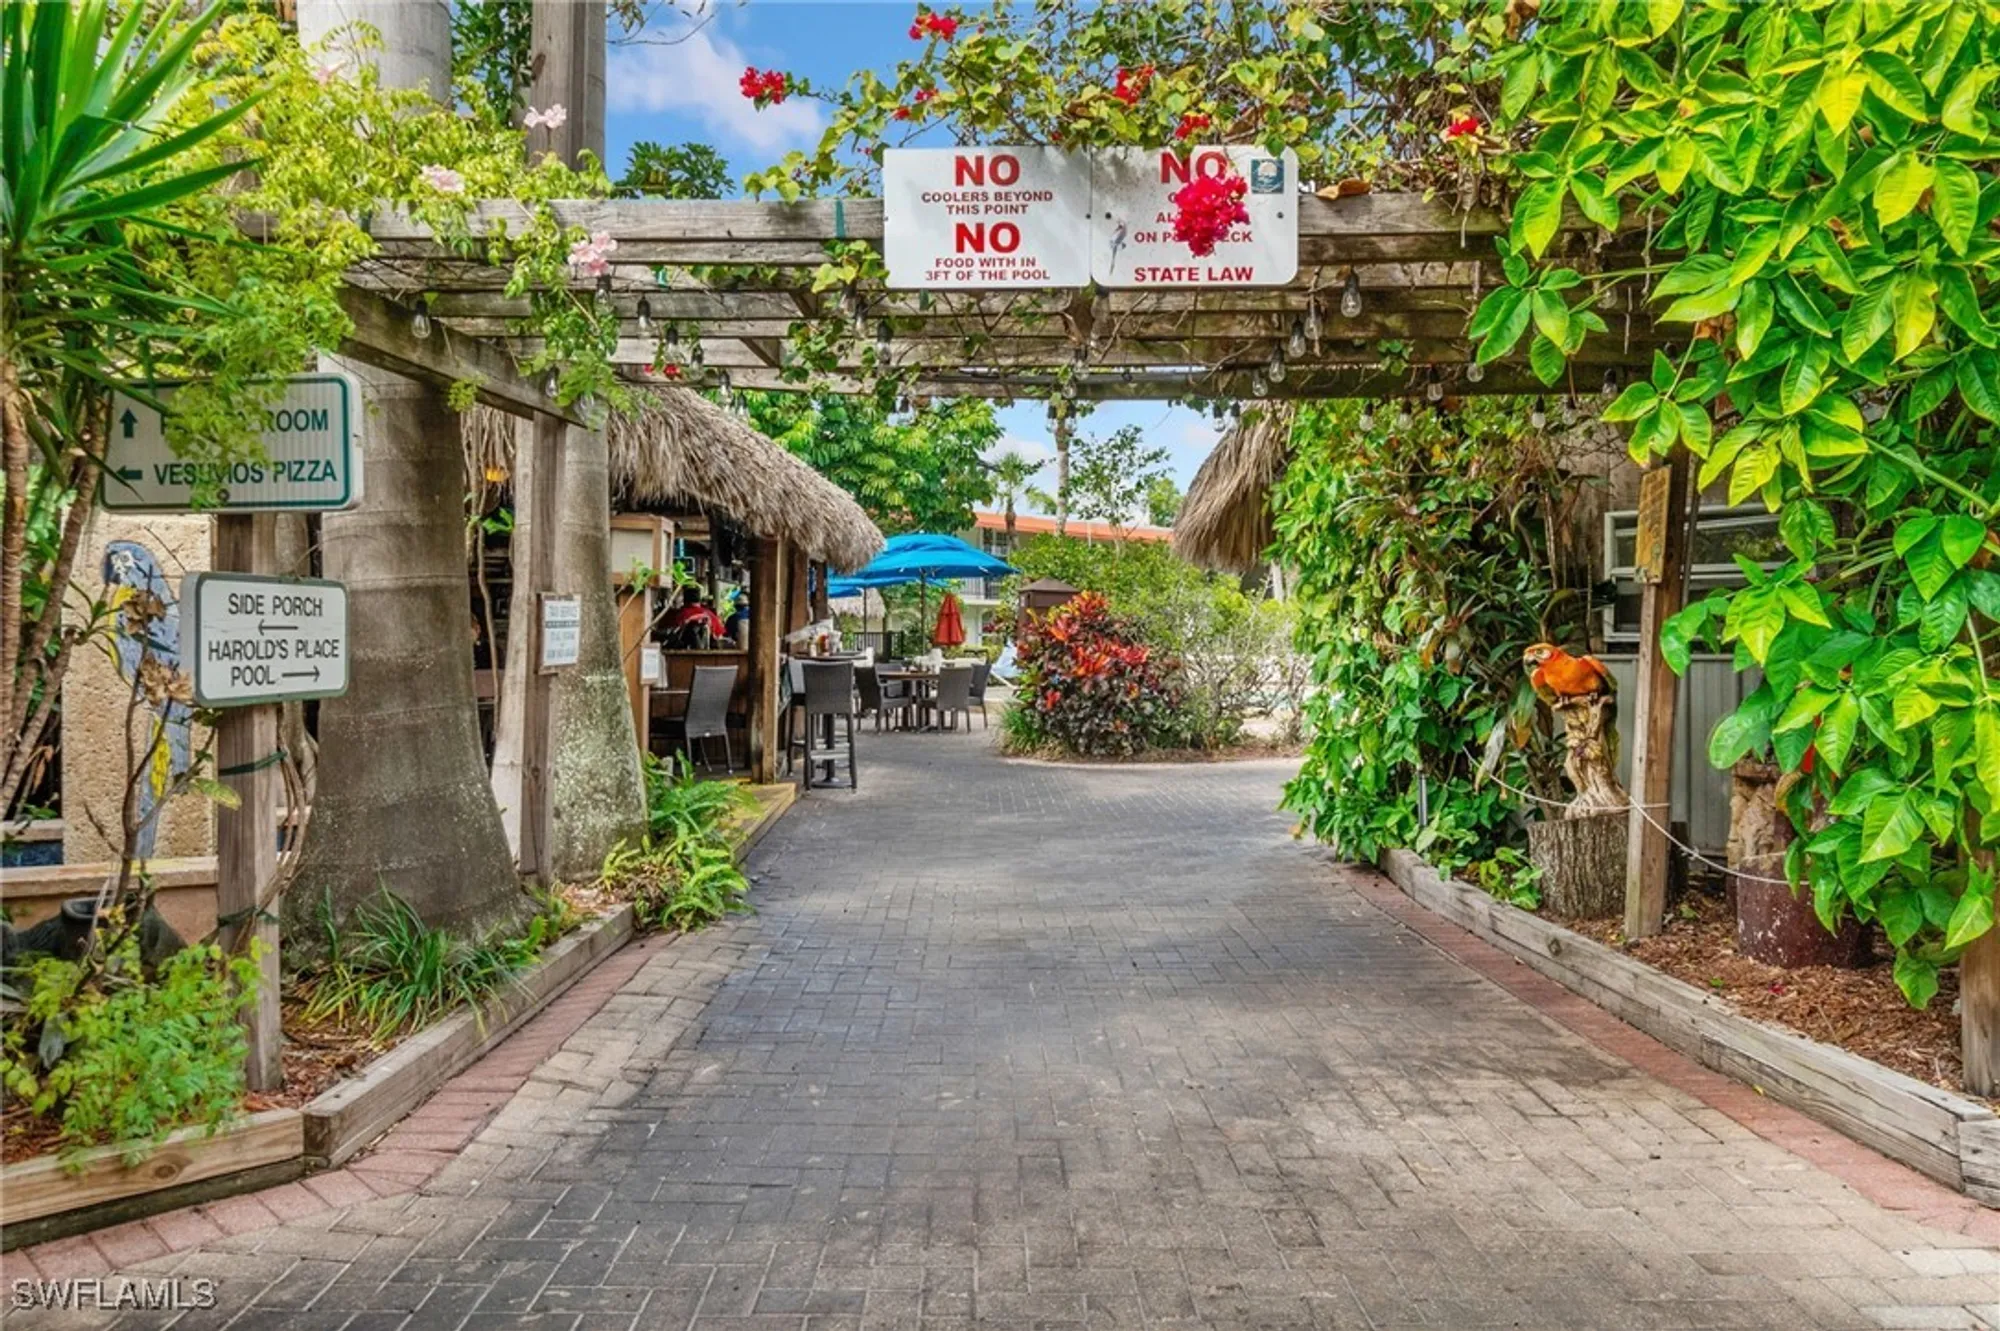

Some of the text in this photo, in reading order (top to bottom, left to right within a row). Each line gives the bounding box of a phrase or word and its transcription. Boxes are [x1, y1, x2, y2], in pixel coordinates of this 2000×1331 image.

[955, 154, 1021, 187] NO
[1160, 151, 1229, 184] NO
[921, 191, 1053, 203] COOLERS BEYOND
[946, 204, 1028, 215] THIS POINT
[955, 221, 1021, 254] NO
[1134, 231, 1157, 243] ON
[935, 257, 1036, 268] FOOD WITH IN
[1134, 266, 1254, 281] STATE LAW
[925, 269, 1051, 281] 3FT OF THE POOL
[273, 459, 337, 482] PIZZA
[228, 593, 323, 616] SIDE PORCH
[208, 639, 340, 661] HAROLD'S PLACE
[231, 665, 276, 687] POOL
